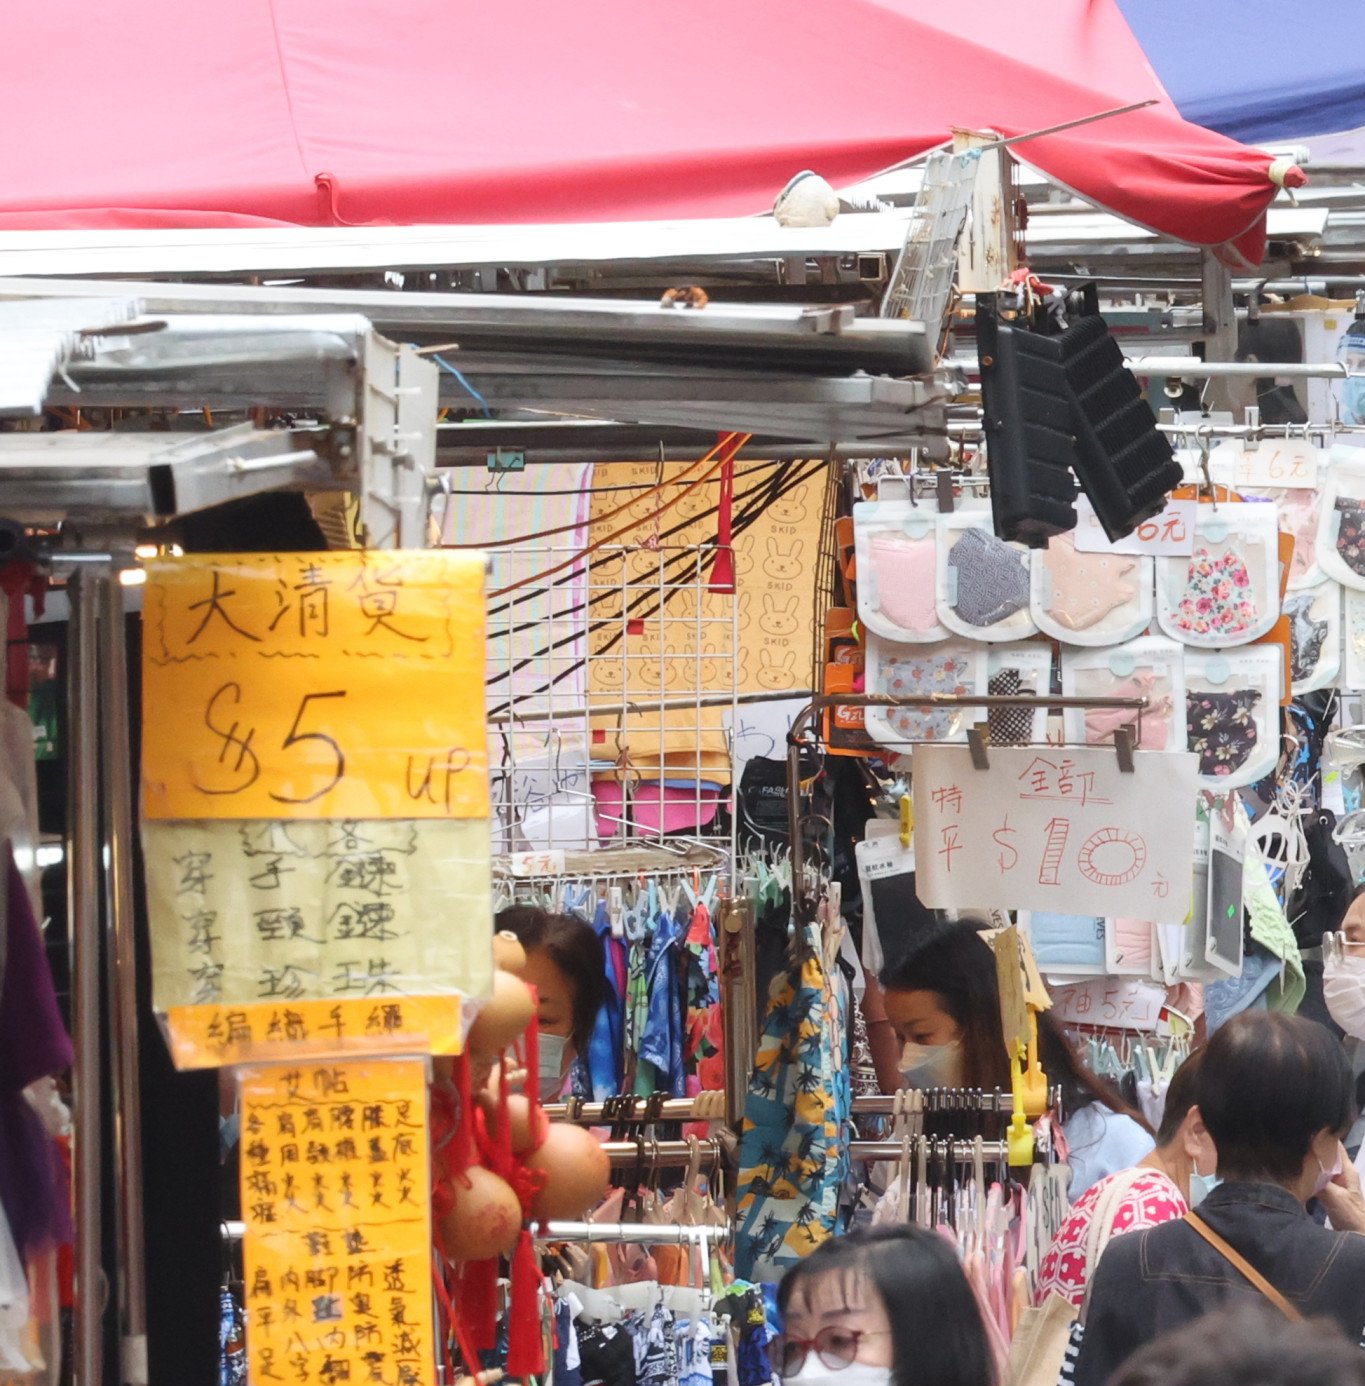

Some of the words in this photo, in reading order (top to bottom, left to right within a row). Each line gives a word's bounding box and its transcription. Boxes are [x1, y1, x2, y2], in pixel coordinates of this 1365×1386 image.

[771, 525, 796, 535] SKID
[767, 581, 792, 591] SKID
[186, 560, 429, 645] 大清貨
[763, 638, 789, 647] SKID
[189, 682, 346, 804] $5
[1018, 756, 1095, 807] 全部
